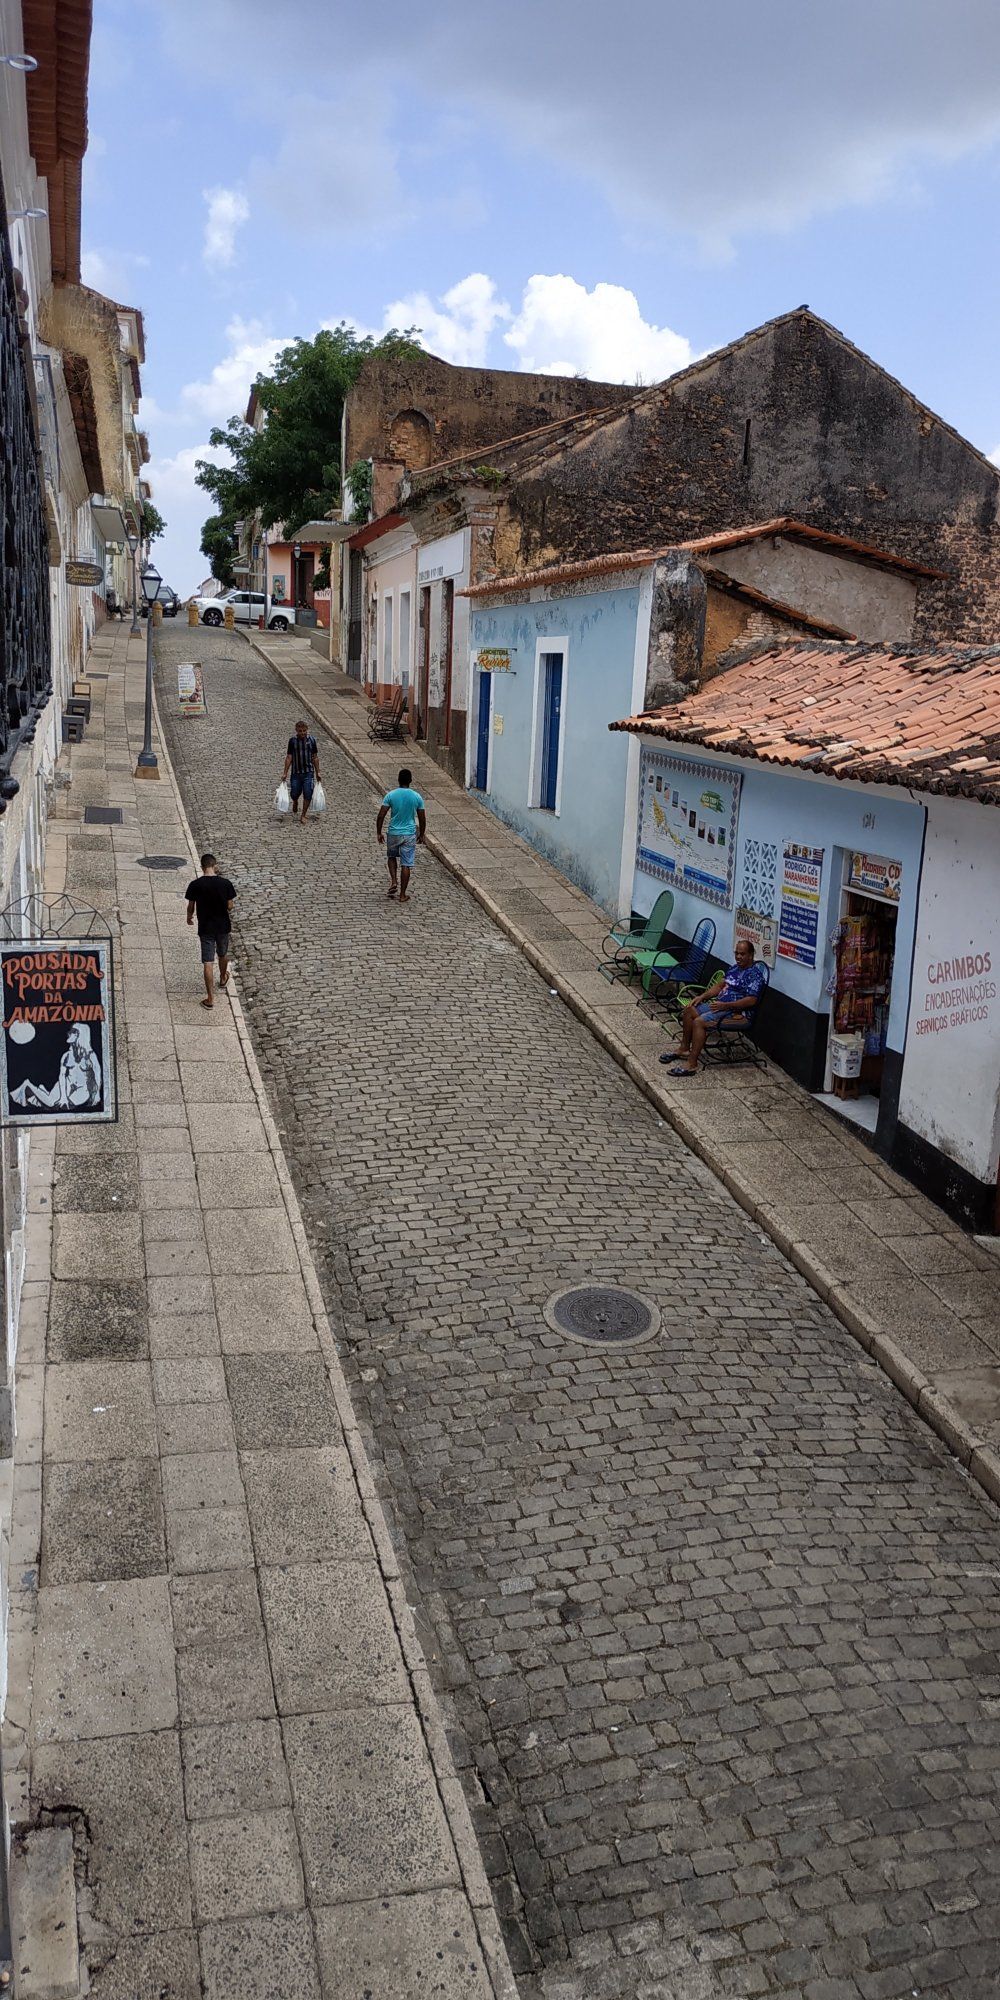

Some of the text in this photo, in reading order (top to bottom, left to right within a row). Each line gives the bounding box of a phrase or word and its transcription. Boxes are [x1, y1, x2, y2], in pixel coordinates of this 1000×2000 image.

[783, 869, 818, 887] MARANHENSE
[784, 860, 807, 874] RODRIGO
[861, 855, 887, 876] RODRIGO
[888, 864, 901, 880] CD
[2, 952, 104, 989] POUSADA
[927, 951, 992, 985] CARIMBOS
[14, 972, 88, 1001] PORTAS
[44, 992, 63, 1004] DA
[924, 980, 997, 1012] ENCADERNAÇÕES
[2, 1000, 105, 1028] AMAZÔNIA
[915, 1004, 989, 1036] SERVIÇOS GRÁFICOS
